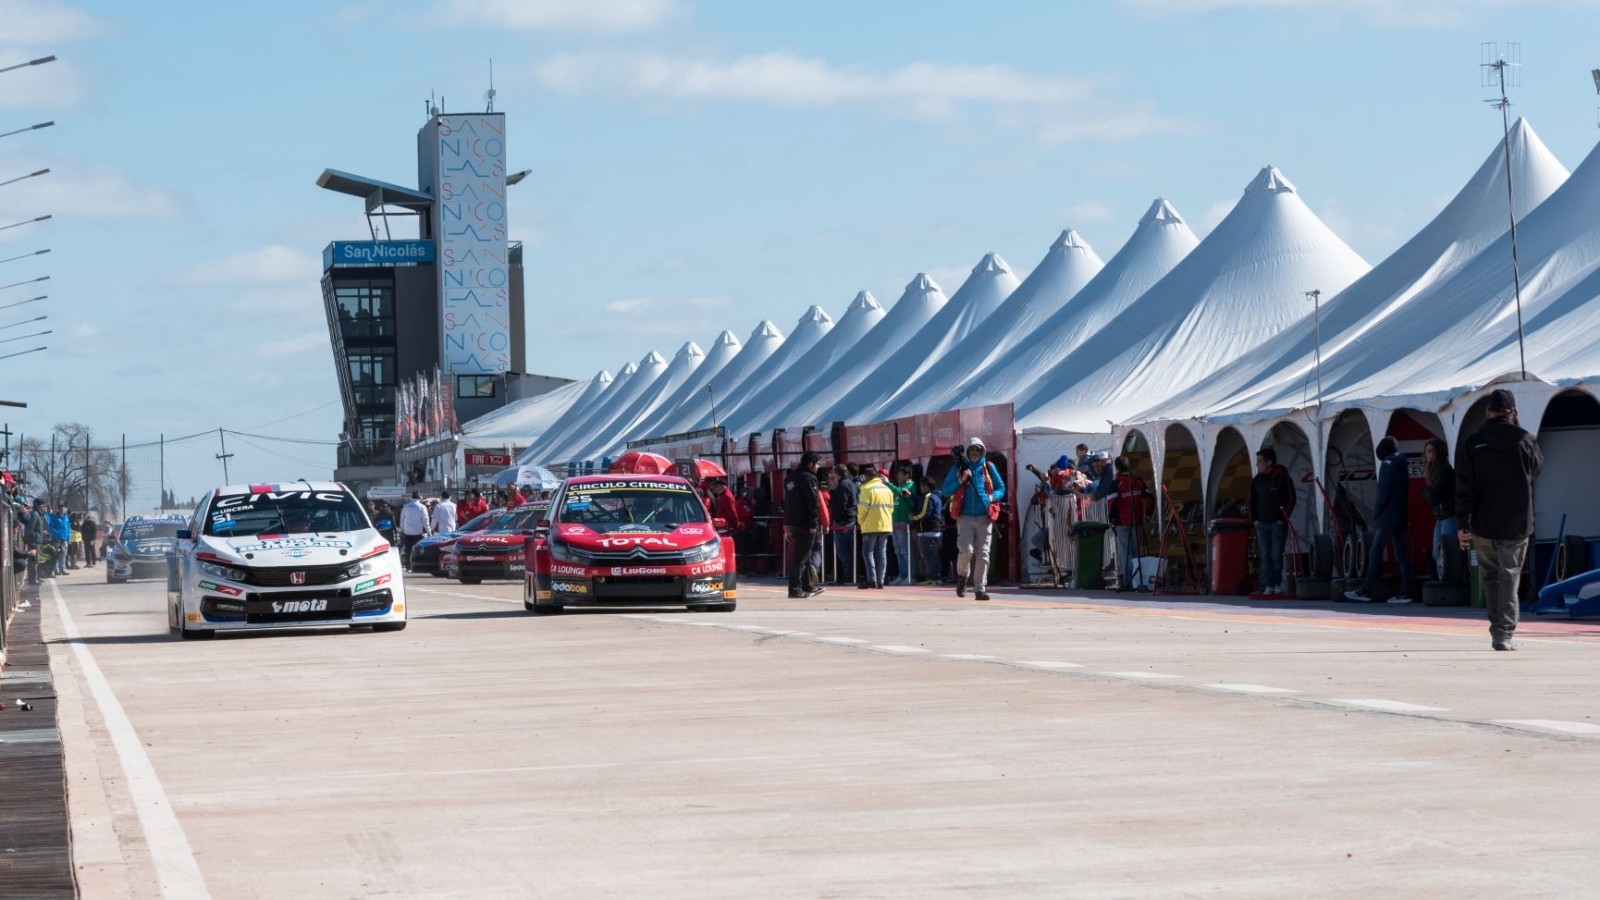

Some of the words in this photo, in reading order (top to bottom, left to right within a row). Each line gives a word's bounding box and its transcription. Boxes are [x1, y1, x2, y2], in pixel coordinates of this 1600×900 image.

[344, 245, 373, 262] San
[371, 244, 425, 257] Nicolás
[472, 455, 485, 464] FIAT
[217, 492, 345, 508] CIVIC
[567, 495, 593, 504] 25
[220, 504, 254, 514] URCERA
[596, 537, 678, 547] TOTAL
[558, 565, 585, 575] LOUNGE
[282, 599, 328, 613] mota
